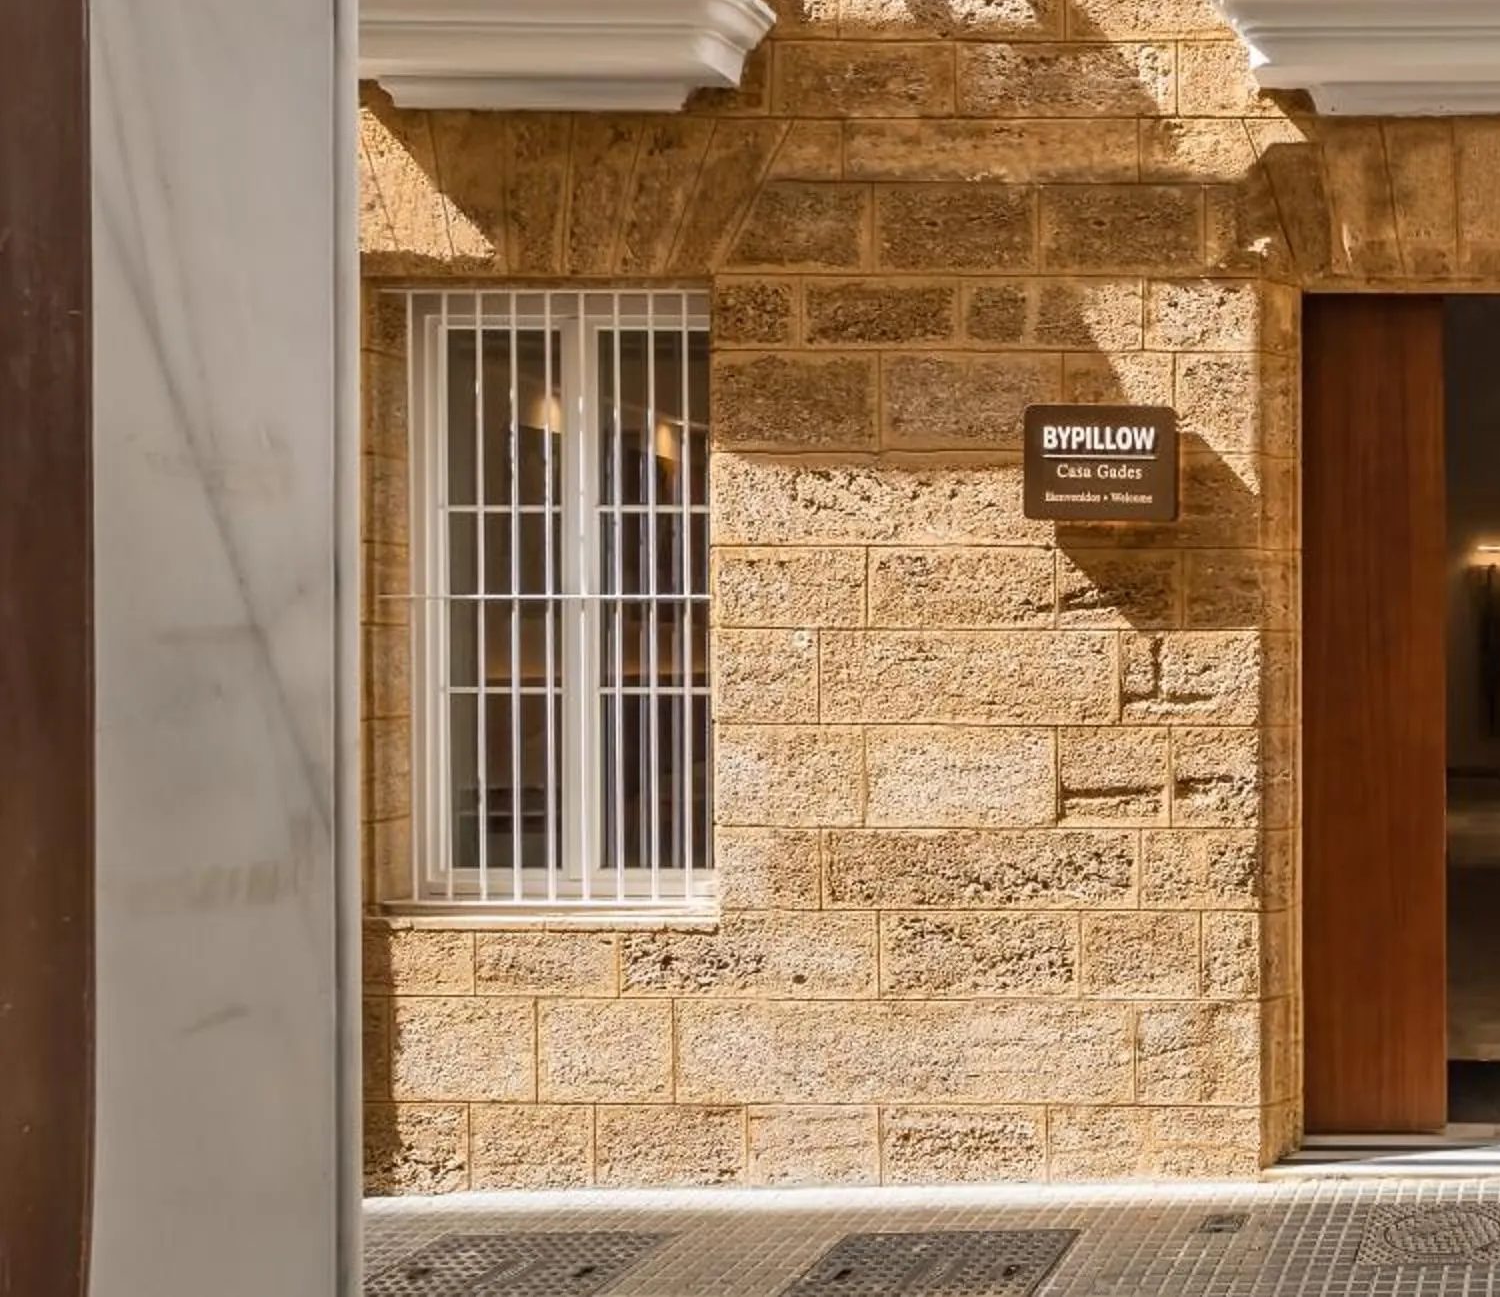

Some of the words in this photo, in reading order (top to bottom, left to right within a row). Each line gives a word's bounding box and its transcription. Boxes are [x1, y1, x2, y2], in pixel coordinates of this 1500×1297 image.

[1043, 426, 1155, 450] BYPILLOW
[1056, 464, 1091, 478] Casa
[1097, 464, 1143, 479] Gades
